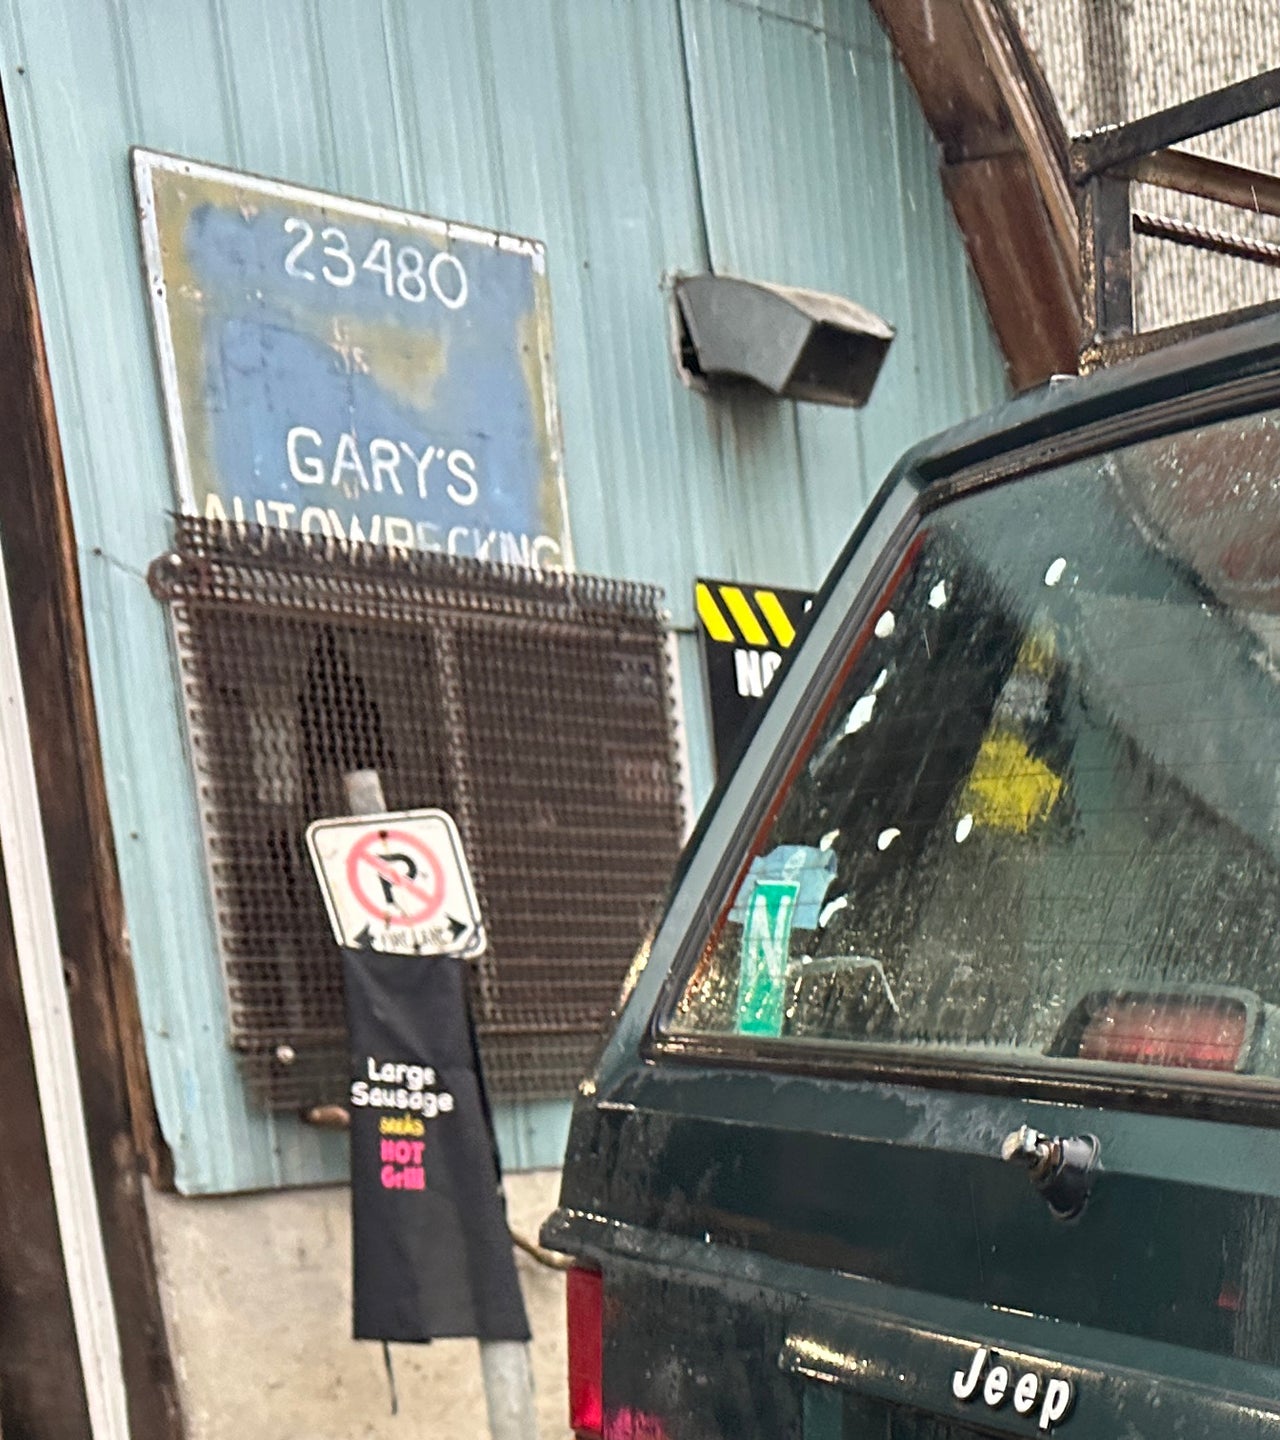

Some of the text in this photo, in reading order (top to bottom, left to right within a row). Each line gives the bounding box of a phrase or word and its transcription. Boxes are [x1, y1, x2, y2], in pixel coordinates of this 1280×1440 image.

[284, 217, 468, 309] 23480
[286, 426, 478, 506] GARY'S
[748, 894, 793, 987] N
[350, 1081, 455, 1118] Sausage
[366, 1056, 436, 1091] Large
[380, 1138, 426, 1165] HOT
[952, 1348, 1072, 1430] Jeep
